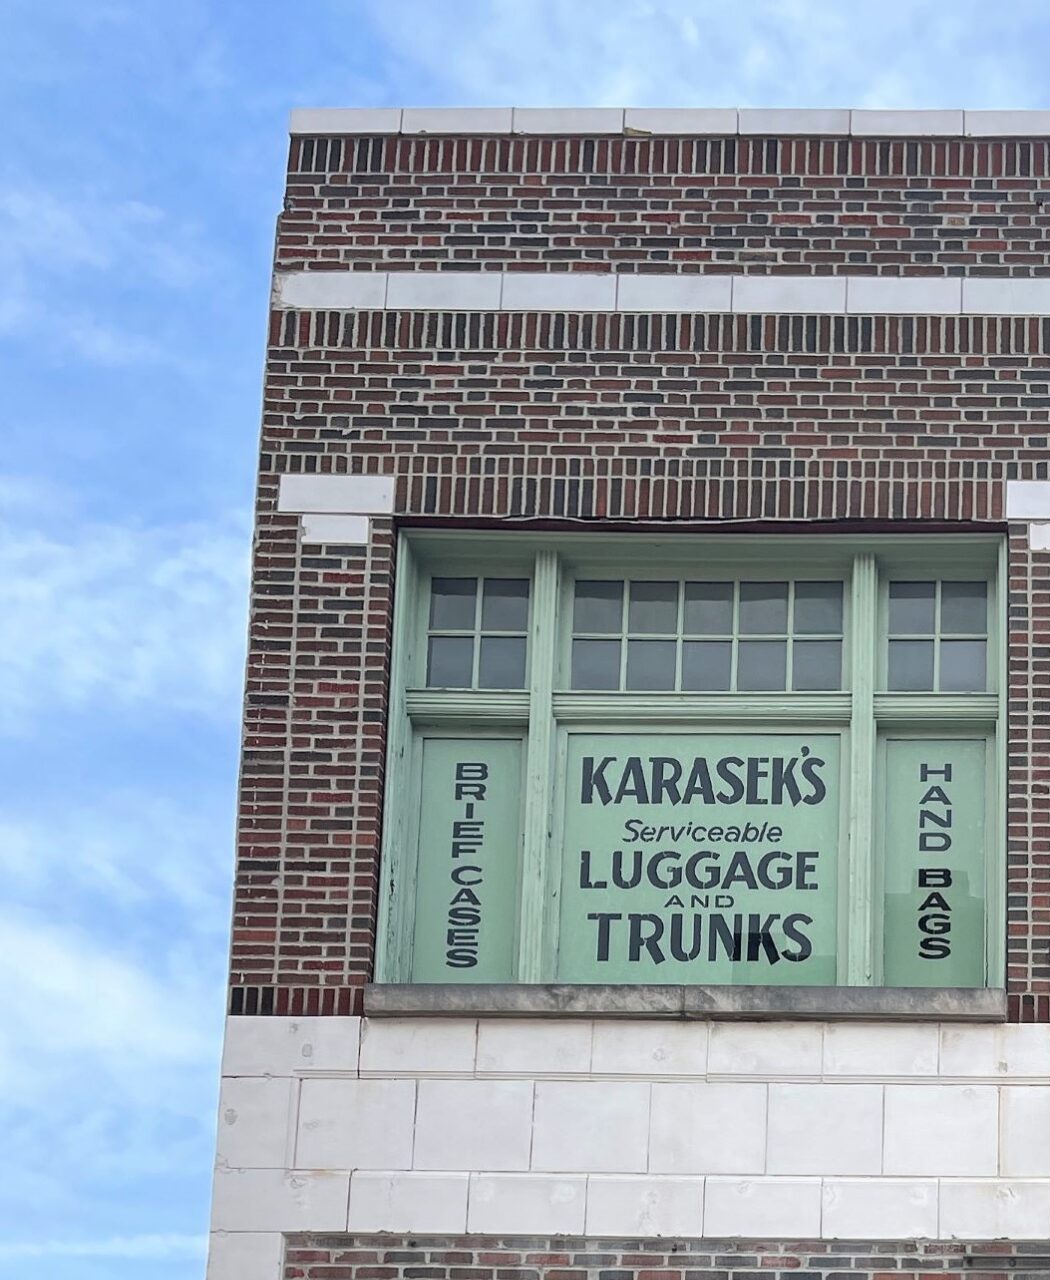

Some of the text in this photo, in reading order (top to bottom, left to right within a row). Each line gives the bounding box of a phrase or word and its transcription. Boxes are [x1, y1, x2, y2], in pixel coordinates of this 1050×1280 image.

[580, 746, 827, 807] KARASEK'S
[622, 819, 783, 843] Serviceable
[446, 762, 489, 969] BRIEF CASES
[579, 850, 820, 890] LUGGAGE
[917, 763, 953, 960] HAND BAGS
[664, 894, 735, 909] AND
[587, 912, 814, 966] TRUNKS
